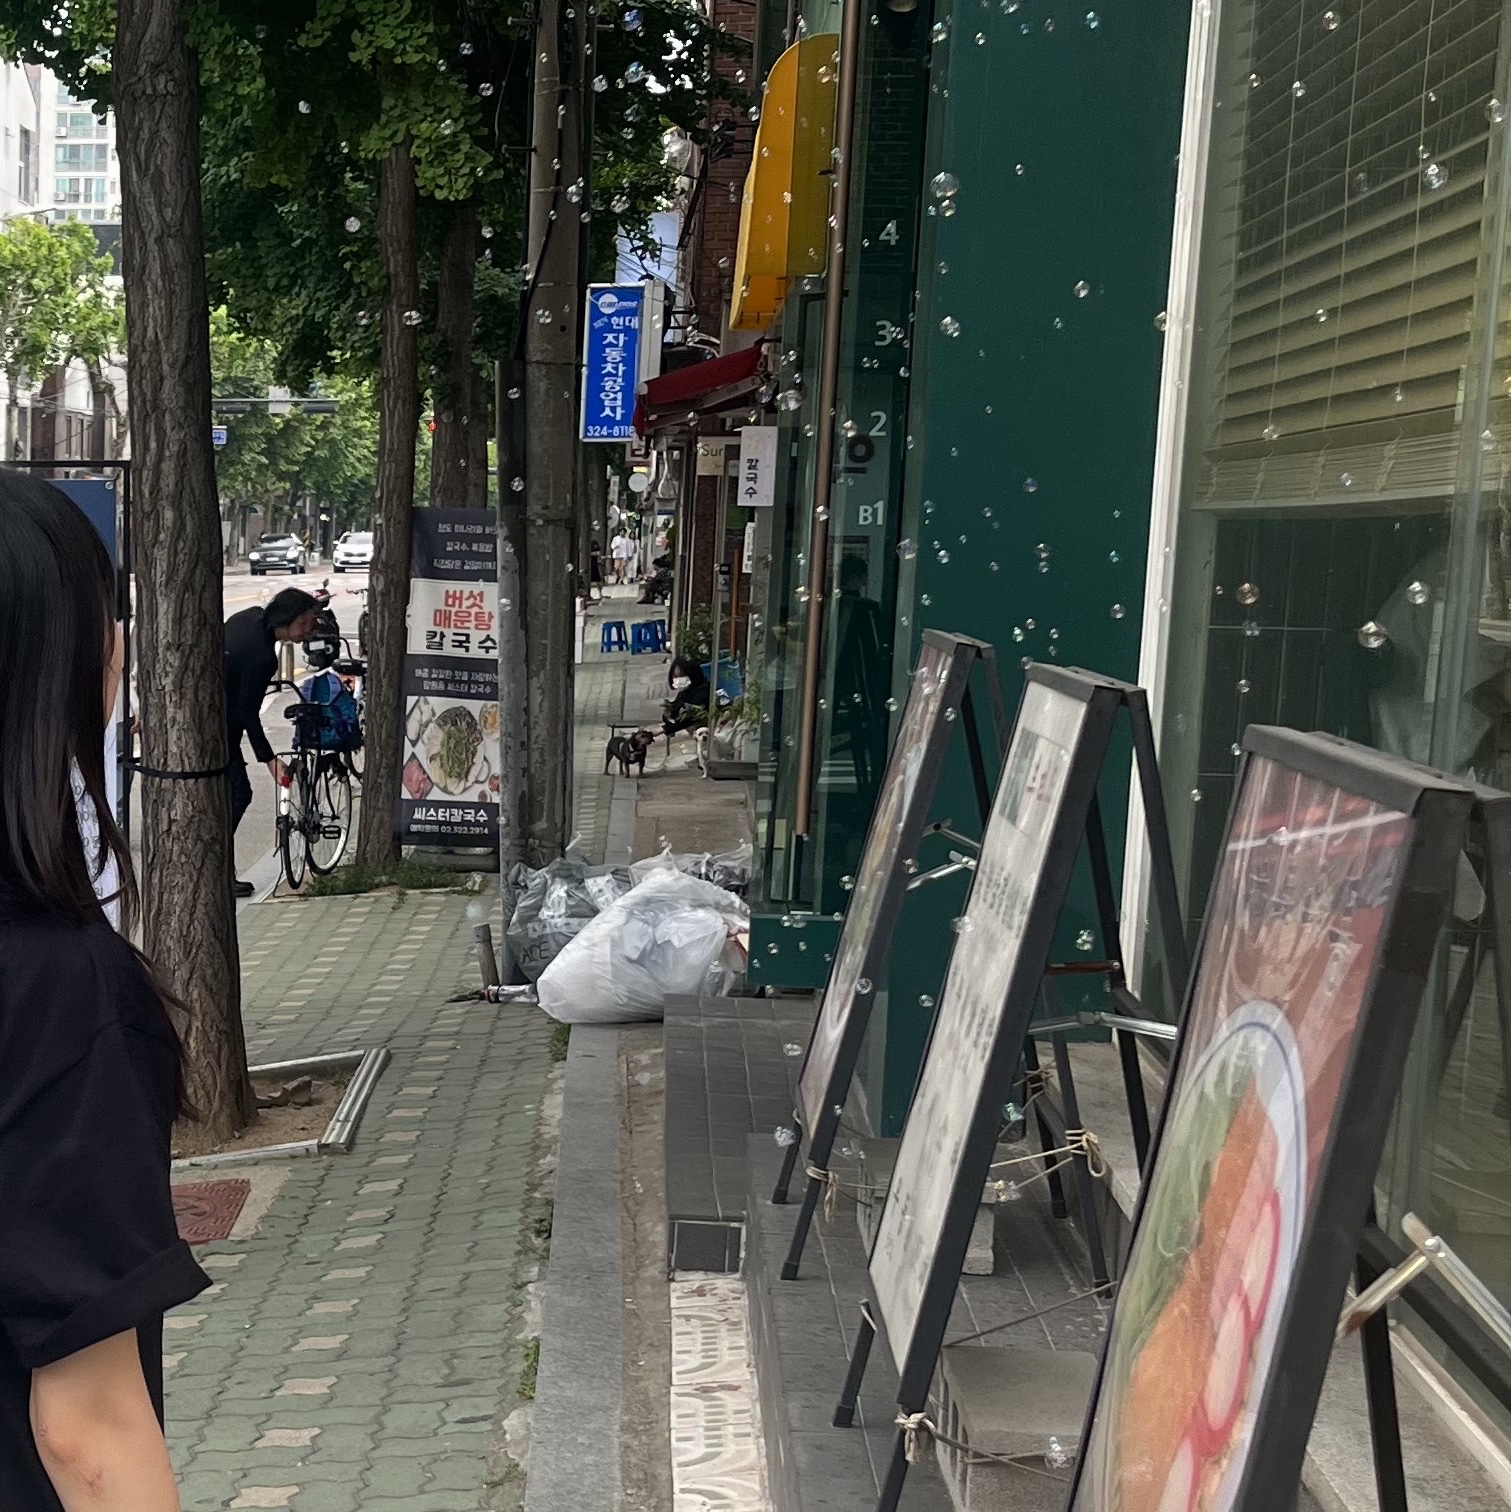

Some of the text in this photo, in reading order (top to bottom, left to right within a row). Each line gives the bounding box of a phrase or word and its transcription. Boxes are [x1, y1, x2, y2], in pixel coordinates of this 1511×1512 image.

[878, 219, 900, 246] 4
[610, 316, 638, 330] 현대
[874, 321, 893, 347] 3
[599, 333, 629, 421] 자동차공업사
[869, 411, 887, 438] 2
[858, 500, 886, 526] B1
[444, 589, 484, 610] 버섯
[433, 609, 494, 631] 매운탕
[425, 630, 498, 654] 칼국수
[412, 806, 488, 823] 씨스터칼국수
